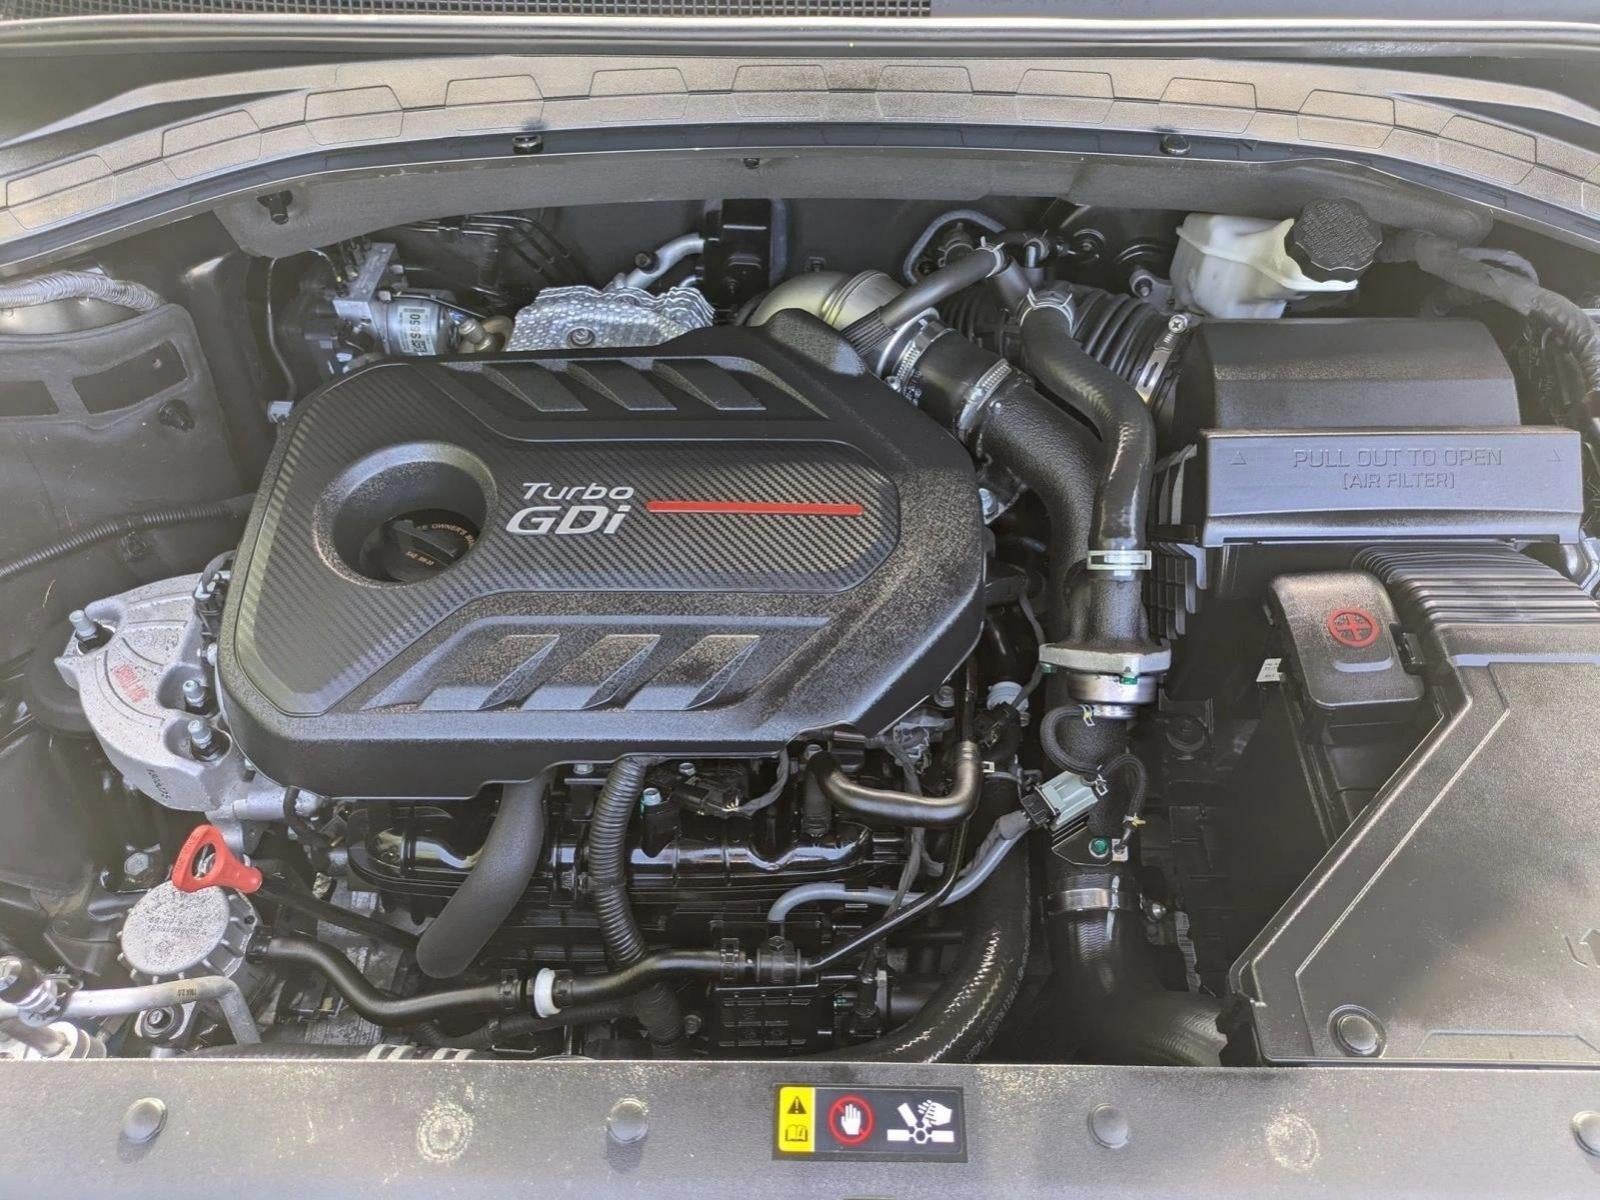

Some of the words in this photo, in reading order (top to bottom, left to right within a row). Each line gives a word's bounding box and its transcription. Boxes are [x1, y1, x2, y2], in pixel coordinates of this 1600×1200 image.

[1293, 448, 1350, 468] PULL
[1357, 448, 1402, 467] OUT
[1408, 448, 1437, 467] TO
[1444, 448, 1502, 467] OPEN
[523, 482, 635, 500] Turbo
[505, 505, 632, 535] GDi
